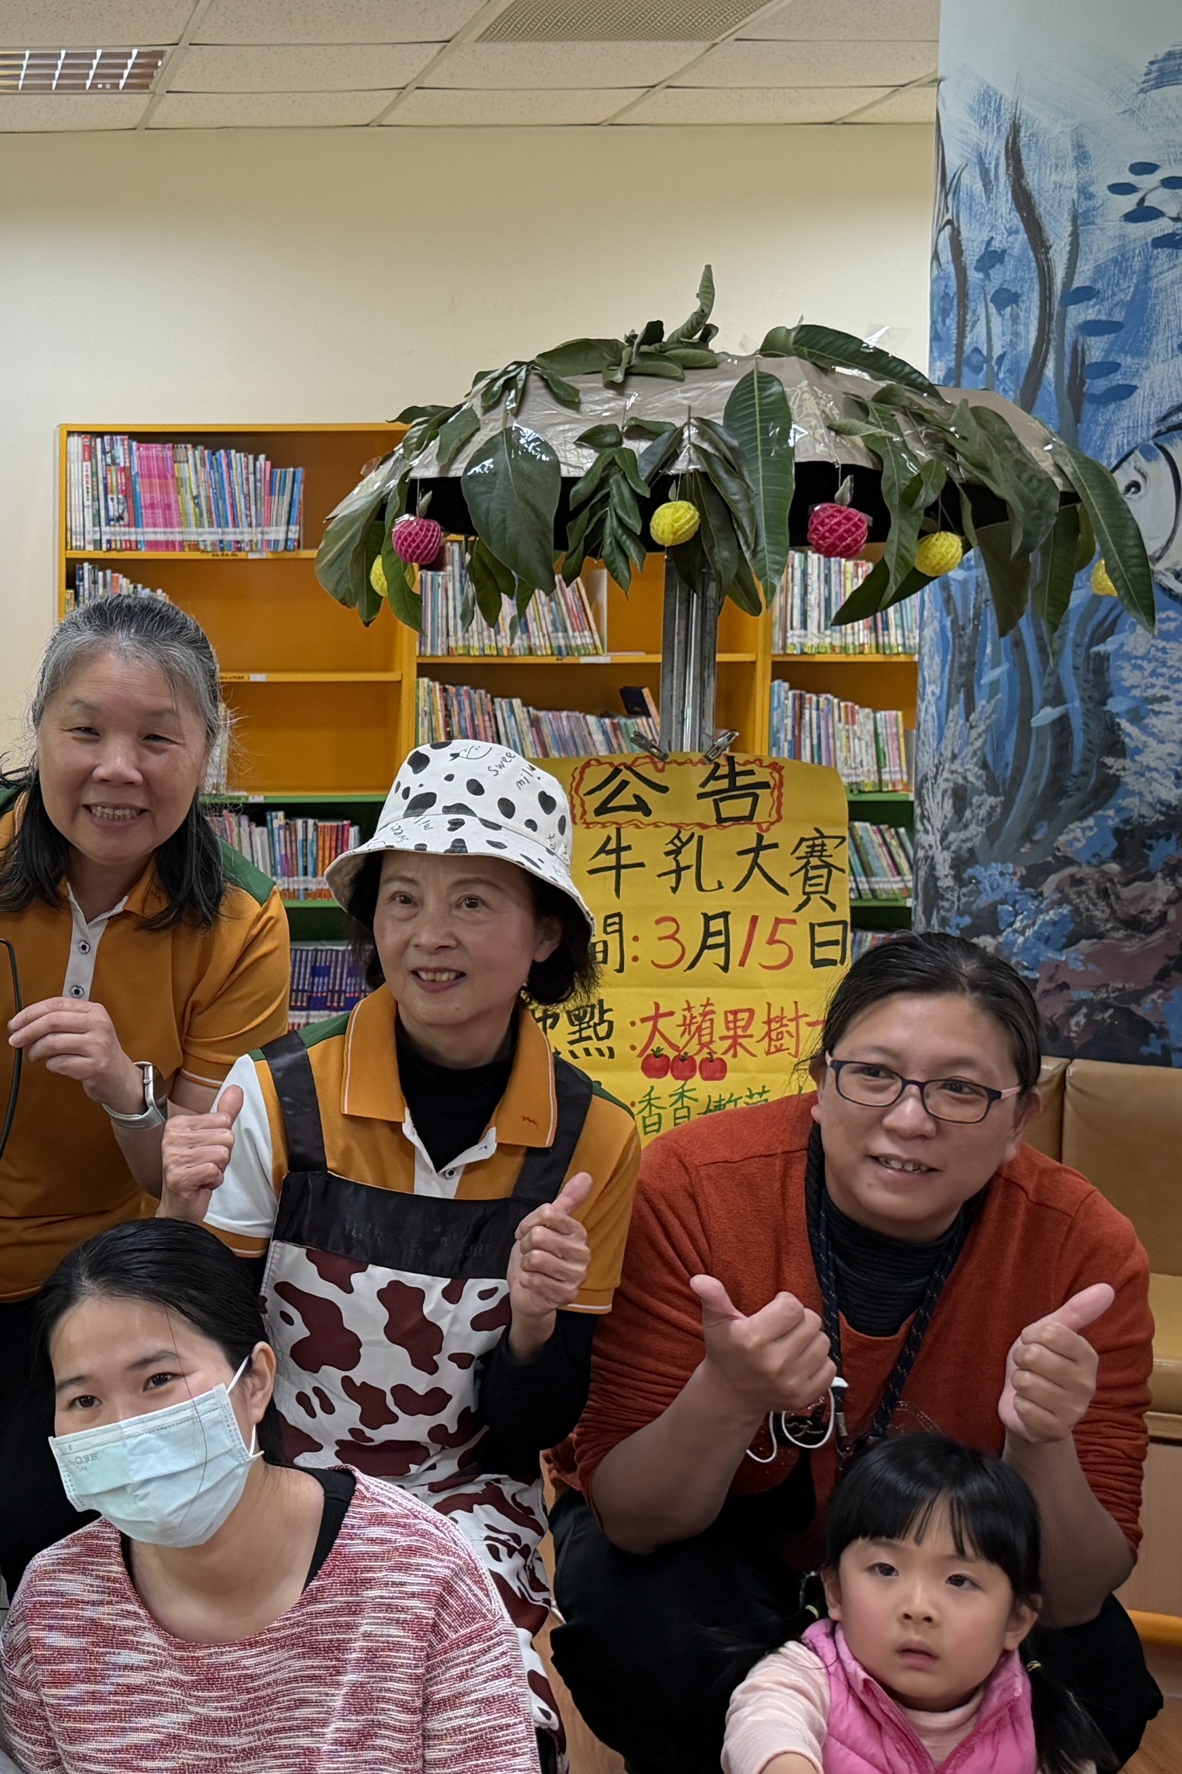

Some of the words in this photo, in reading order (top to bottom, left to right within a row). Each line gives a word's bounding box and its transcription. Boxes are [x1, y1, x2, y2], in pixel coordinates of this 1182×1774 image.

[487, 751, 516, 777] Swee
[584, 755, 772, 824] 公告
[587, 827, 847, 913] 牛乳大賽
[530, 997, 825, 1060] 點:大蘋果樹
